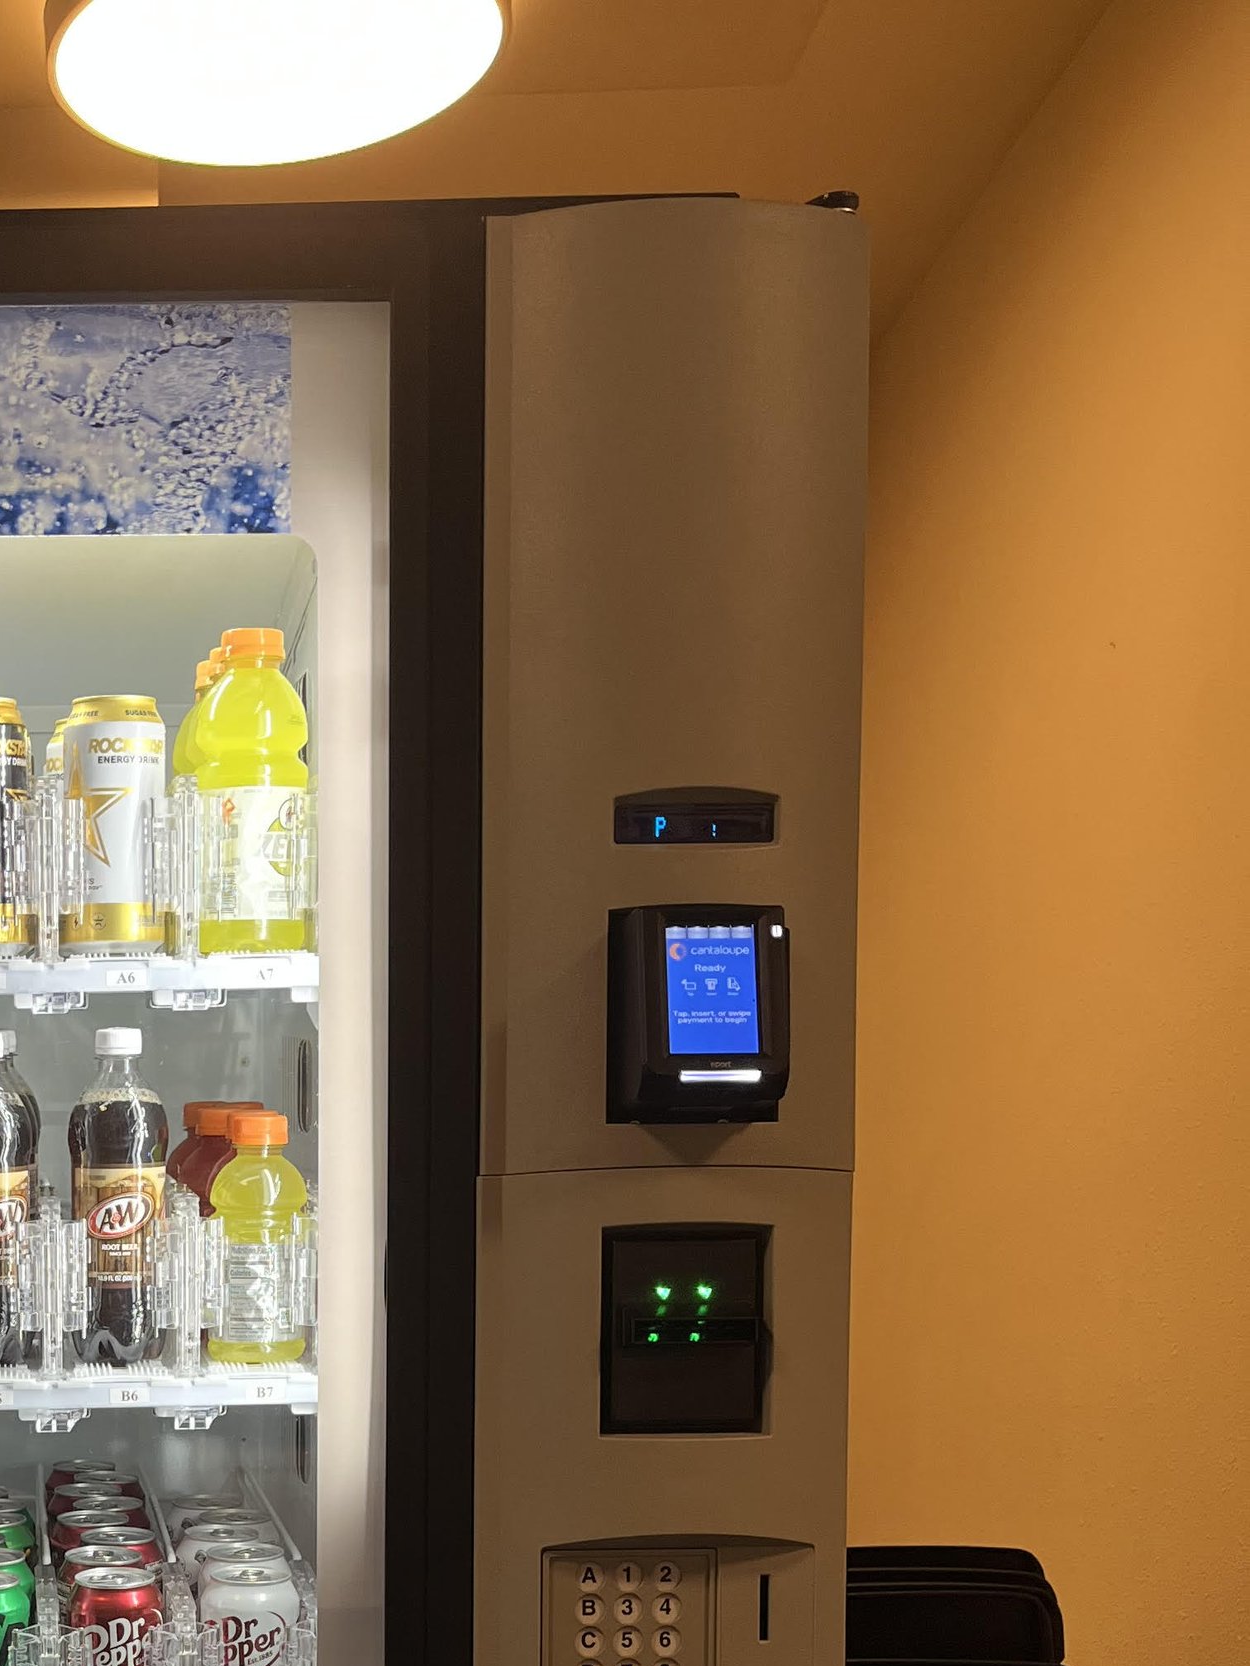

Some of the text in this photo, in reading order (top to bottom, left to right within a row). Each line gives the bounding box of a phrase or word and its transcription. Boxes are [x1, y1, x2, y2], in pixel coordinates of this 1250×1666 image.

[97, 755, 135, 765] ENERGY
[654, 815, 667, 838] P
[690, 945, 750, 956] cantaloupe
[256, 968, 273, 981] A7
[694, 963, 727, 973] Ready
[116, 972, 135, 985] A6
[677, 1017, 713, 1025] payment
[724, 1016, 748, 1025] begin
[728, 1010, 751, 1018] swipe
[101, 1243, 120, 1251] ROOT
[121, 1390, 138, 1402] B6
[256, 1387, 273, 1399] B7
[581, 1567, 597, 1584] A
[622, 1567, 632, 1582] 1
[660, 1566, 672, 1583] 2
[581, 1599, 596, 1616] B
[621, 1598, 633, 1615] 3
[659, 1598, 672, 1615] 4
[108, 1616, 146, 1648] Dr
[222, 1616, 259, 1644] Dr
[581, 1631, 597, 1648] C
[621, 1631, 633, 1648] 5
[659, 1631, 671, 1648] 6
